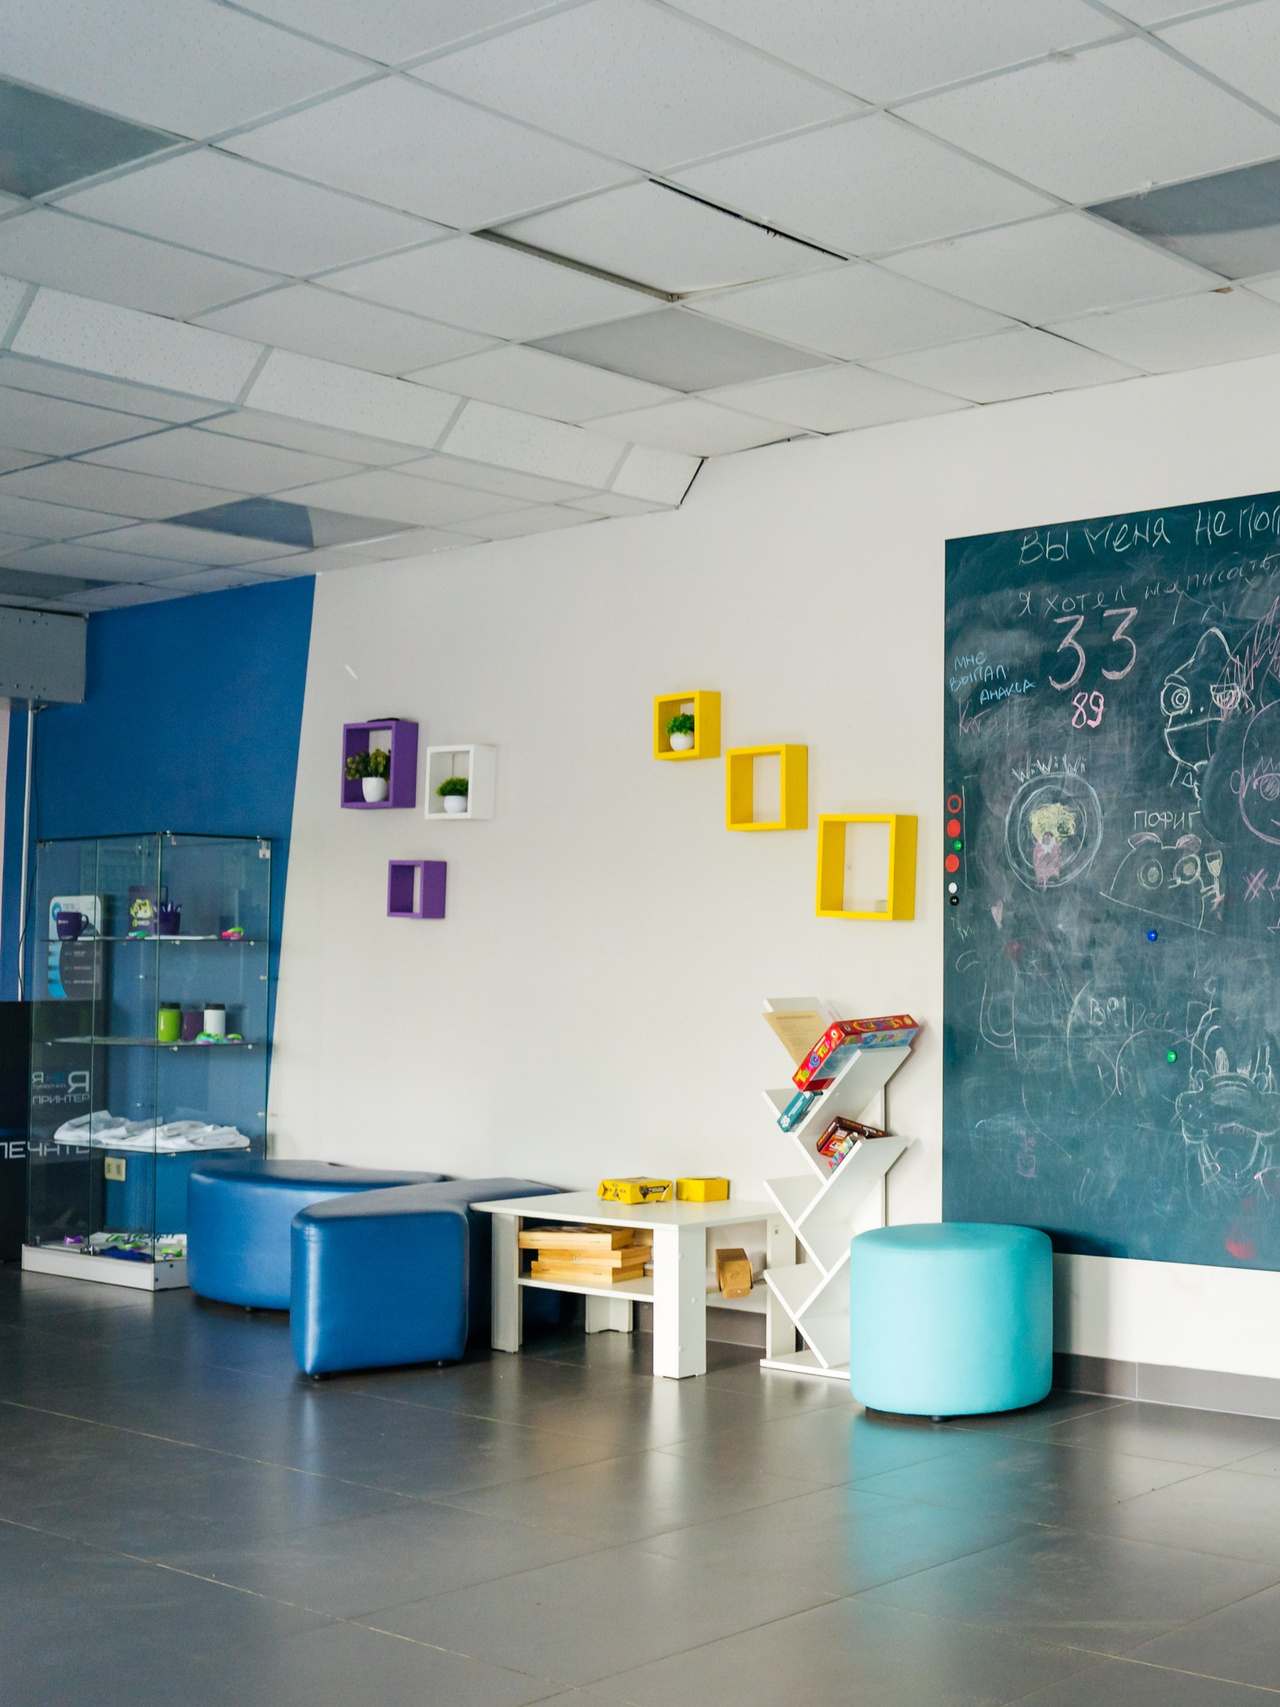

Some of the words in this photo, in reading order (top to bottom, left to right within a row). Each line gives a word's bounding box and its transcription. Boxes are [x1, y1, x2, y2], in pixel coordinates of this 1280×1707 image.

[1071, 691, 1105, 729] 89
[1133, 810, 1202, 831] ПОФИГ
[32, 1093, 90, 1105] ПРИНТЕР
